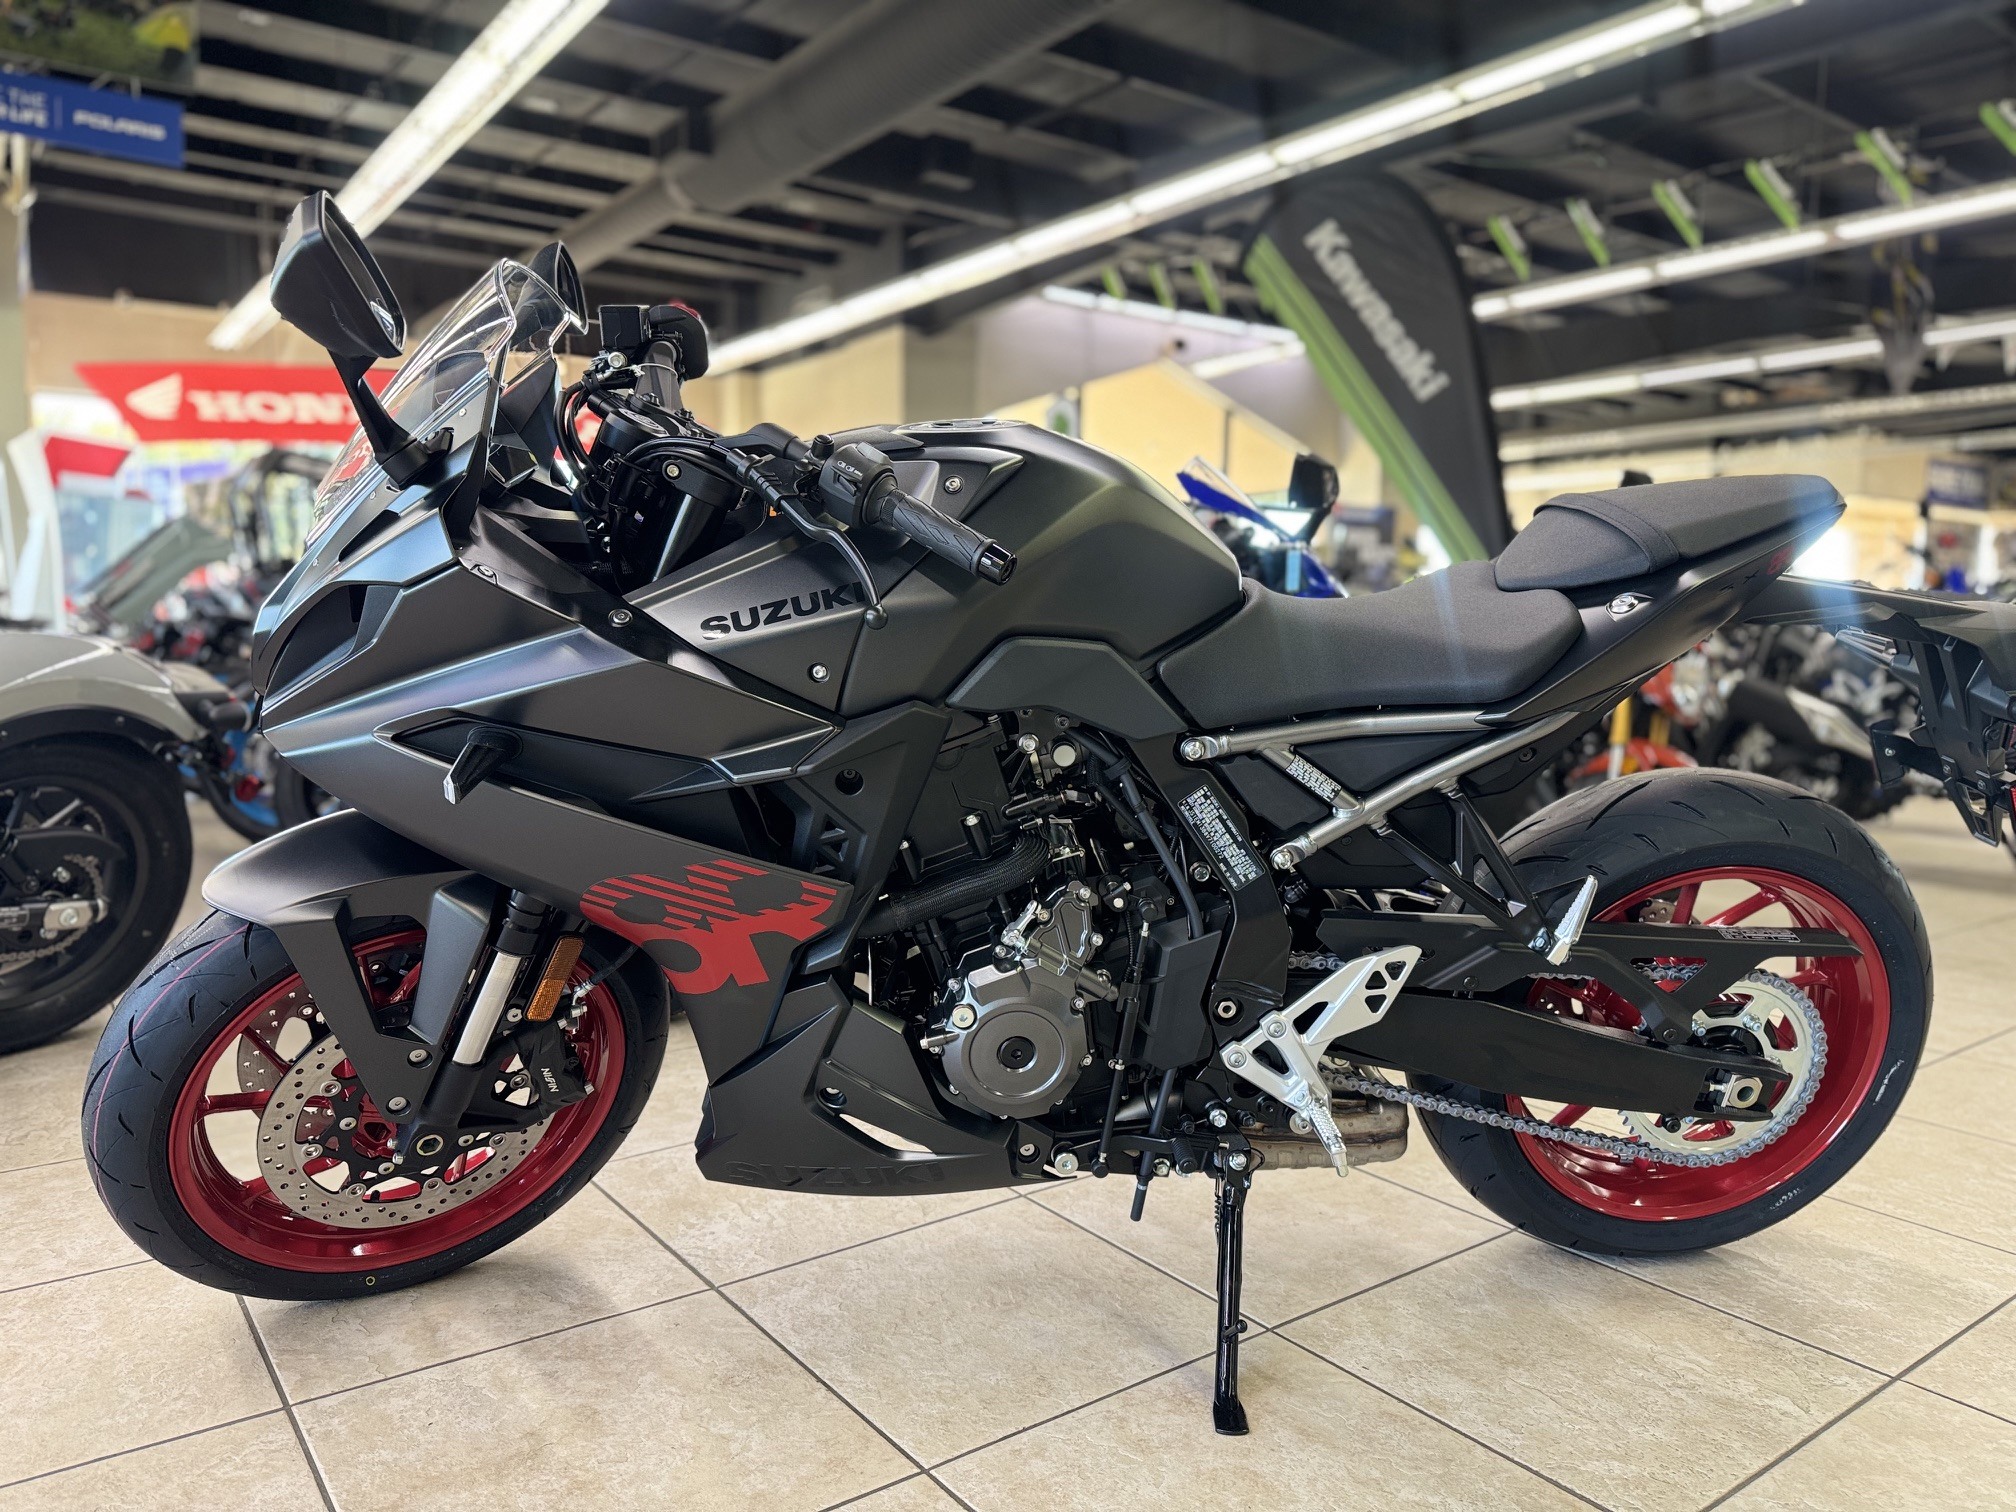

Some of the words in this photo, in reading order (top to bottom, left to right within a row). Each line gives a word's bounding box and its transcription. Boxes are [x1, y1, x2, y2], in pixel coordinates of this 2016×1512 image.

[73, 108, 168, 142] POLARIS
[1302, 216, 1450, 404] Kawasaki
[699, 581, 866, 641] SUZUKI
[724, 1161, 946, 1188] SUZUKI
